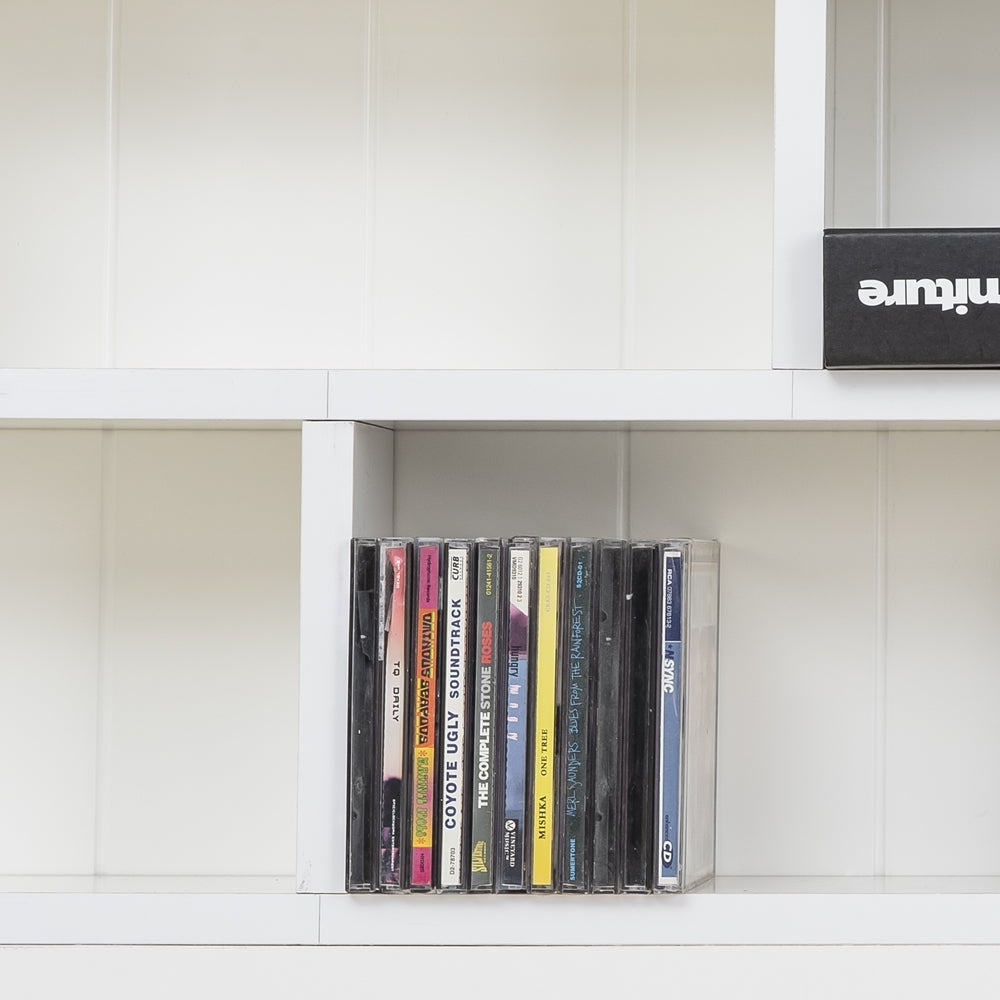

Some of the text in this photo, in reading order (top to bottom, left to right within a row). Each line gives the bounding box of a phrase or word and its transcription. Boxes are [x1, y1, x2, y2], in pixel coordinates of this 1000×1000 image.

[452, 555, 460, 581] CURB
[570, 598, 584, 660] RAINFOREST
[508, 645, 521, 677] hungry
[570, 662, 581, 680] THE
[392, 661, 400, 722] TQ DAILY
[570, 683, 582, 706] FROM
[444, 598, 461, 829] COYOTE UGLY SOUNDTRACK
[478, 621, 492, 808] THE COMPLETE STONE ROSES
[568, 708, 579, 734] BLUES
[538, 795, 546, 840] MISHKA
[566, 789, 580, 817] MERL
[662, 840, 673, 863] CD
